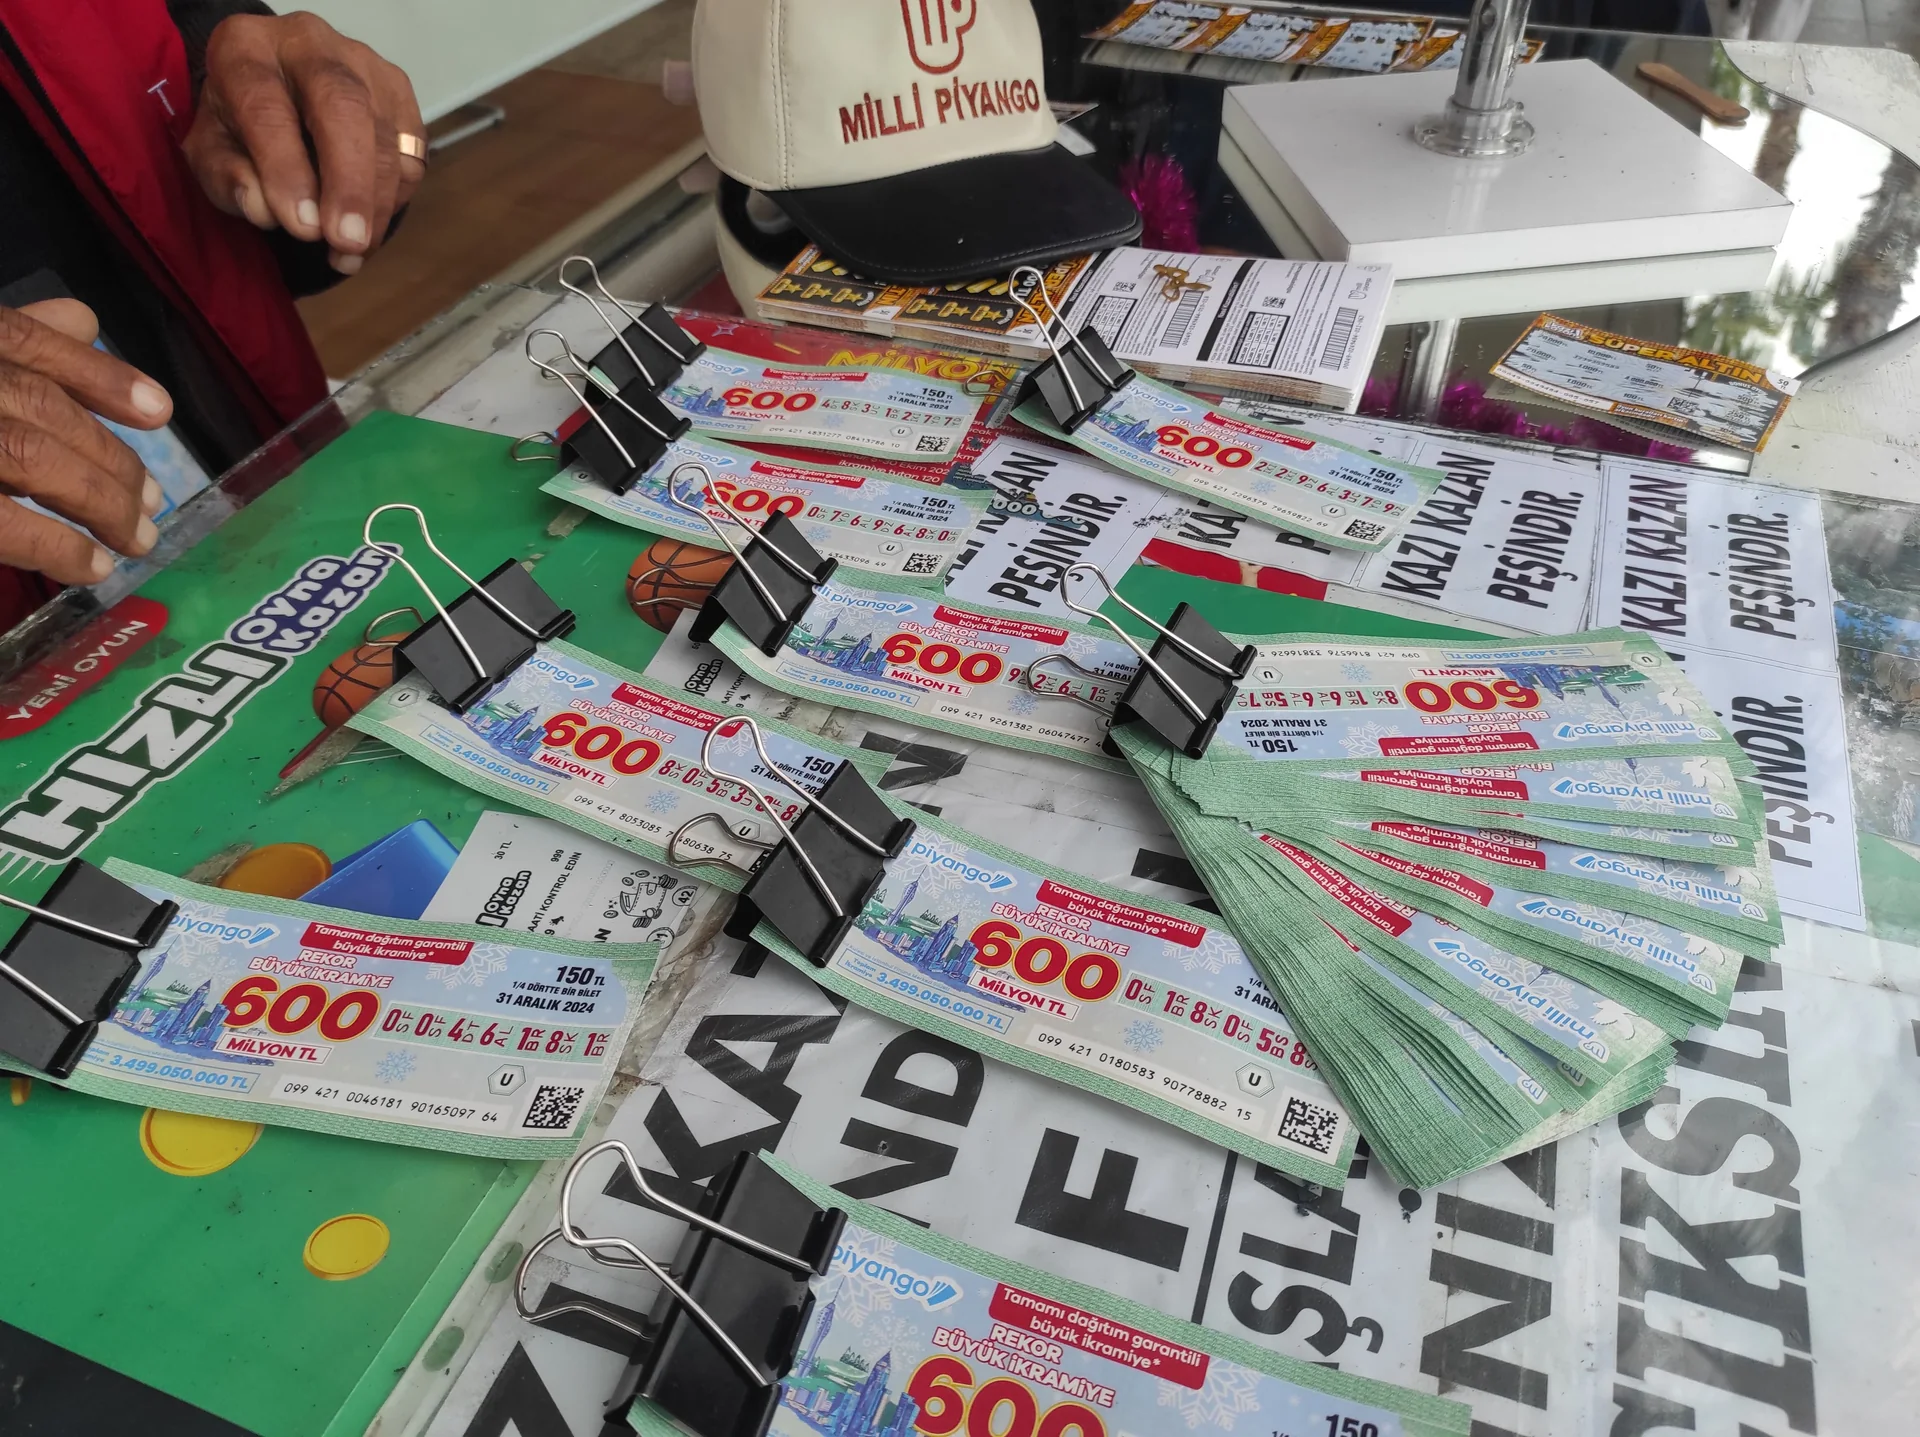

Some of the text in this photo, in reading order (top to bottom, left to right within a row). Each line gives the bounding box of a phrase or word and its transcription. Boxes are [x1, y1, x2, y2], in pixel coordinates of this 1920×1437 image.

[839, 75, 1041, 144] MİLLİ PİYANGO
[1586, 333, 1763, 383] SÜPER ALTIN
[922, 388, 945, 398] 150
[1777, 378, 1789, 387] 50
[721, 387, 818, 412] 600
[898, 397, 927, 407] ARALIK
[1201, 422, 1238, 438] REKOR
[1156, 425, 1254, 468] 600
[921, 475, 940, 483] 120
[1202, 464, 1215, 473] TL
[1369, 467, 1395, 481] 150
[1328, 469, 1396, 495] 31 ARALIK 2024
[702, 480, 805, 519] 600
[922, 496, 948, 508] 150
[1329, 507, 1338, 515] U
[893, 506, 924, 519] ARALIK
[1625, 474, 1688, 565] KAZAN
[1381, 451, 1497, 600] KAZI KAZAN
[885, 544, 895, 552] U
[238, 556, 339, 643] Oyna
[830, 593, 897, 613] piyango
[1620, 565, 1688, 637] KAZI
[934, 621, 979, 639] REKOR
[943, 607, 1064, 637] Tamamı dağıtım garantili
[958, 619, 991, 630] büyük
[73, 619, 150, 675] OYUN
[880, 632, 1004, 685] 600
[809, 675, 897, 700] 3.499.050.000
[947, 684, 963, 695] TL
[1402, 679, 1541, 714] 600
[607, 701, 652, 723] REKOR
[624, 684, 699, 717] Tamamı dağıtım
[940, 705, 1090, 744] 099 421 9261382 06047477
[1241, 719, 1328, 727] 31 ARALIK 2024
[1469, 723, 1521, 733] REKOR
[1574, 721, 1695, 737] milli piyango
[2, 649, 280, 851] HIZLI
[540, 711, 663, 776] 600
[1262, 739, 1299, 753] 150
[1388, 742, 1534, 756] Tamamı garantili
[452, 742, 536, 787] 3.499.050.000
[801, 756, 836, 775] 150
[1575, 781, 1663, 802] piyango
[574, 795, 662, 834] 099 421 8053085
[738, 827, 752, 836] U
[494, 840, 513, 860] 30 TL
[550, 849, 564, 863] 999
[911, 841, 991, 884] piyango
[541, 873, 570, 912] KONTROL
[564, 851, 582, 875] EDİN
[1598, 858, 1689, 890] piyango
[678, 889, 694, 904] 42
[991, 902, 1049, 932] BÜYÜK
[1035, 903, 1092, 931] REKOR
[1048, 883, 1199, 936] Tamamı dağıtım garantili
[1067, 901, 1106, 920] büyük
[315, 924, 467, 951] Tamamı dağıtım garantili
[1546, 906, 1644, 948] piyango
[300, 950, 356, 968] REKOR
[332, 941, 371, 954] büyük
[249, 957, 310, 979] BÜYÜK
[969, 919, 1122, 1002] 600
[556, 965, 606, 986] 150 TL
[1454, 951, 1546, 1007] piyango
[512, 980, 602, 998] 1/4 DÖRTTE BİR BİLET
[876, 972, 1003, 1030] 3.499.050.000 TL
[1234, 985, 1252, 999] 31
[221, 974, 382, 1042] 600
[496, 992, 595, 1014] 31 ARALIK 2024
[1047, 1001, 1067, 1016] TL
[299, 1047, 318, 1061] TL
[109, 1054, 248, 1088] 3.499.050.000 TL
[500, 1072, 514, 1087] U
[1038, 1032, 1252, 1122] 099 421 0180583 90778882 15
[1248, 1072, 1262, 1087] U
[284, 1082, 499, 1123] 099 421 0046181 90165097 64
[1003, 1287, 1202, 1369] Tamamı dağıtım garantili
[1028, 1316, 1080, 1346] büyük
[932, 1326, 1010, 1370] BÜYÜK
[990, 1323, 1064, 1365] REKOR
